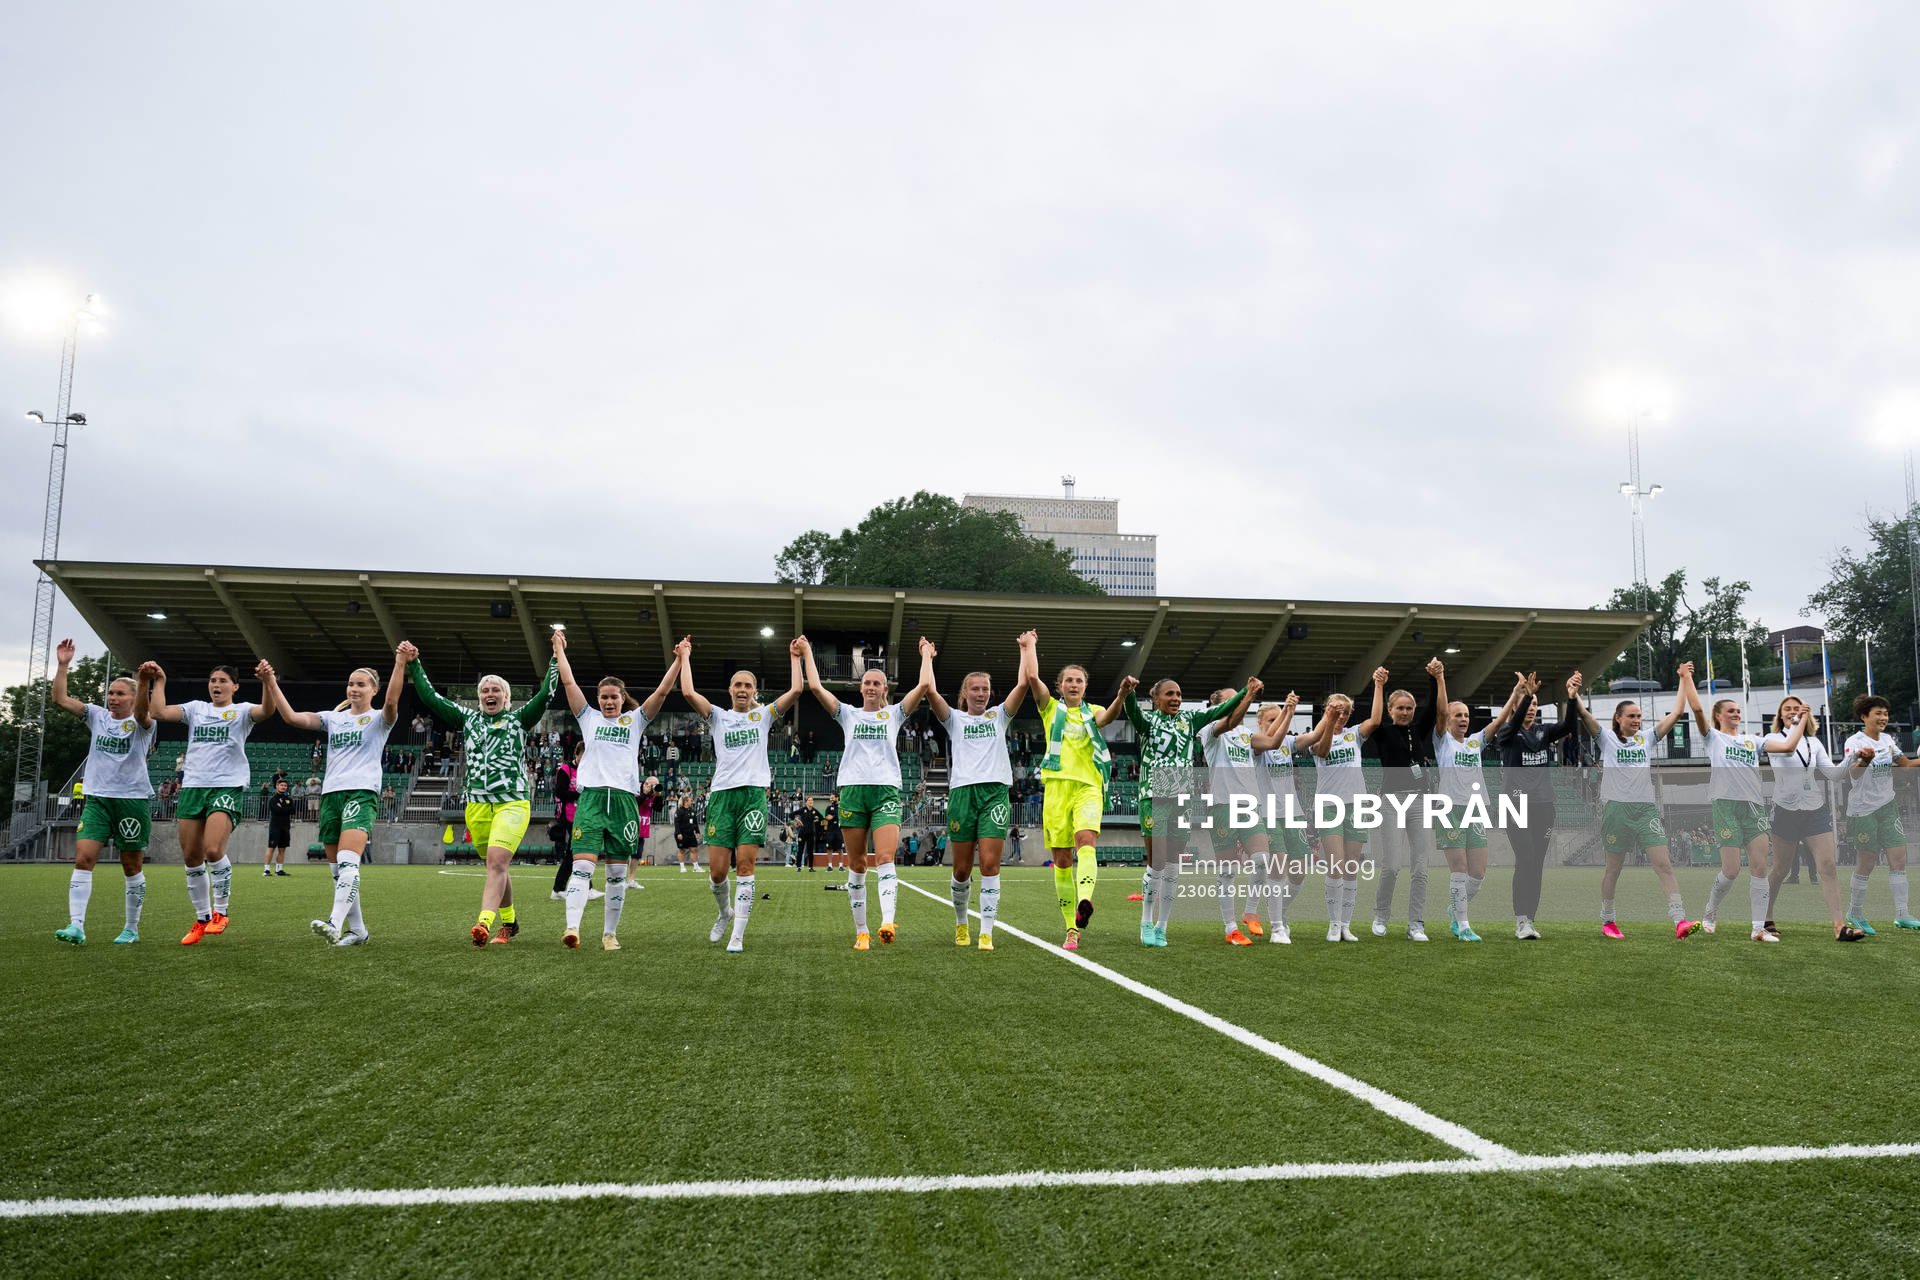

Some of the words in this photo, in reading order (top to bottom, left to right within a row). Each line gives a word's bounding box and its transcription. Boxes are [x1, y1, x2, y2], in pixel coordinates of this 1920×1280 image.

[194, 726, 230, 737] HUSKI
[595, 726, 630, 738] HUSKI
[854, 723, 888, 734] HUSKI
[963, 723, 996, 735] HUSKI
[330, 730, 363, 744] HUSKI
[594, 735, 629, 745] CHOCOLATE
[724, 728, 760, 743] HUSKI
[963, 731, 997, 740] CHOCOLATE
[96, 734, 131, 749] HUSKI
[725, 738, 760, 749] CHOCOLATE
[1326, 747, 1355, 760] HUSKI
[1522, 749, 1548, 760] HUSKI
[1617, 748, 1647, 758] HUSKI
[1725, 746, 1756, 760] HUSKI
[1725, 756, 1756, 765] CHOCOLATE
